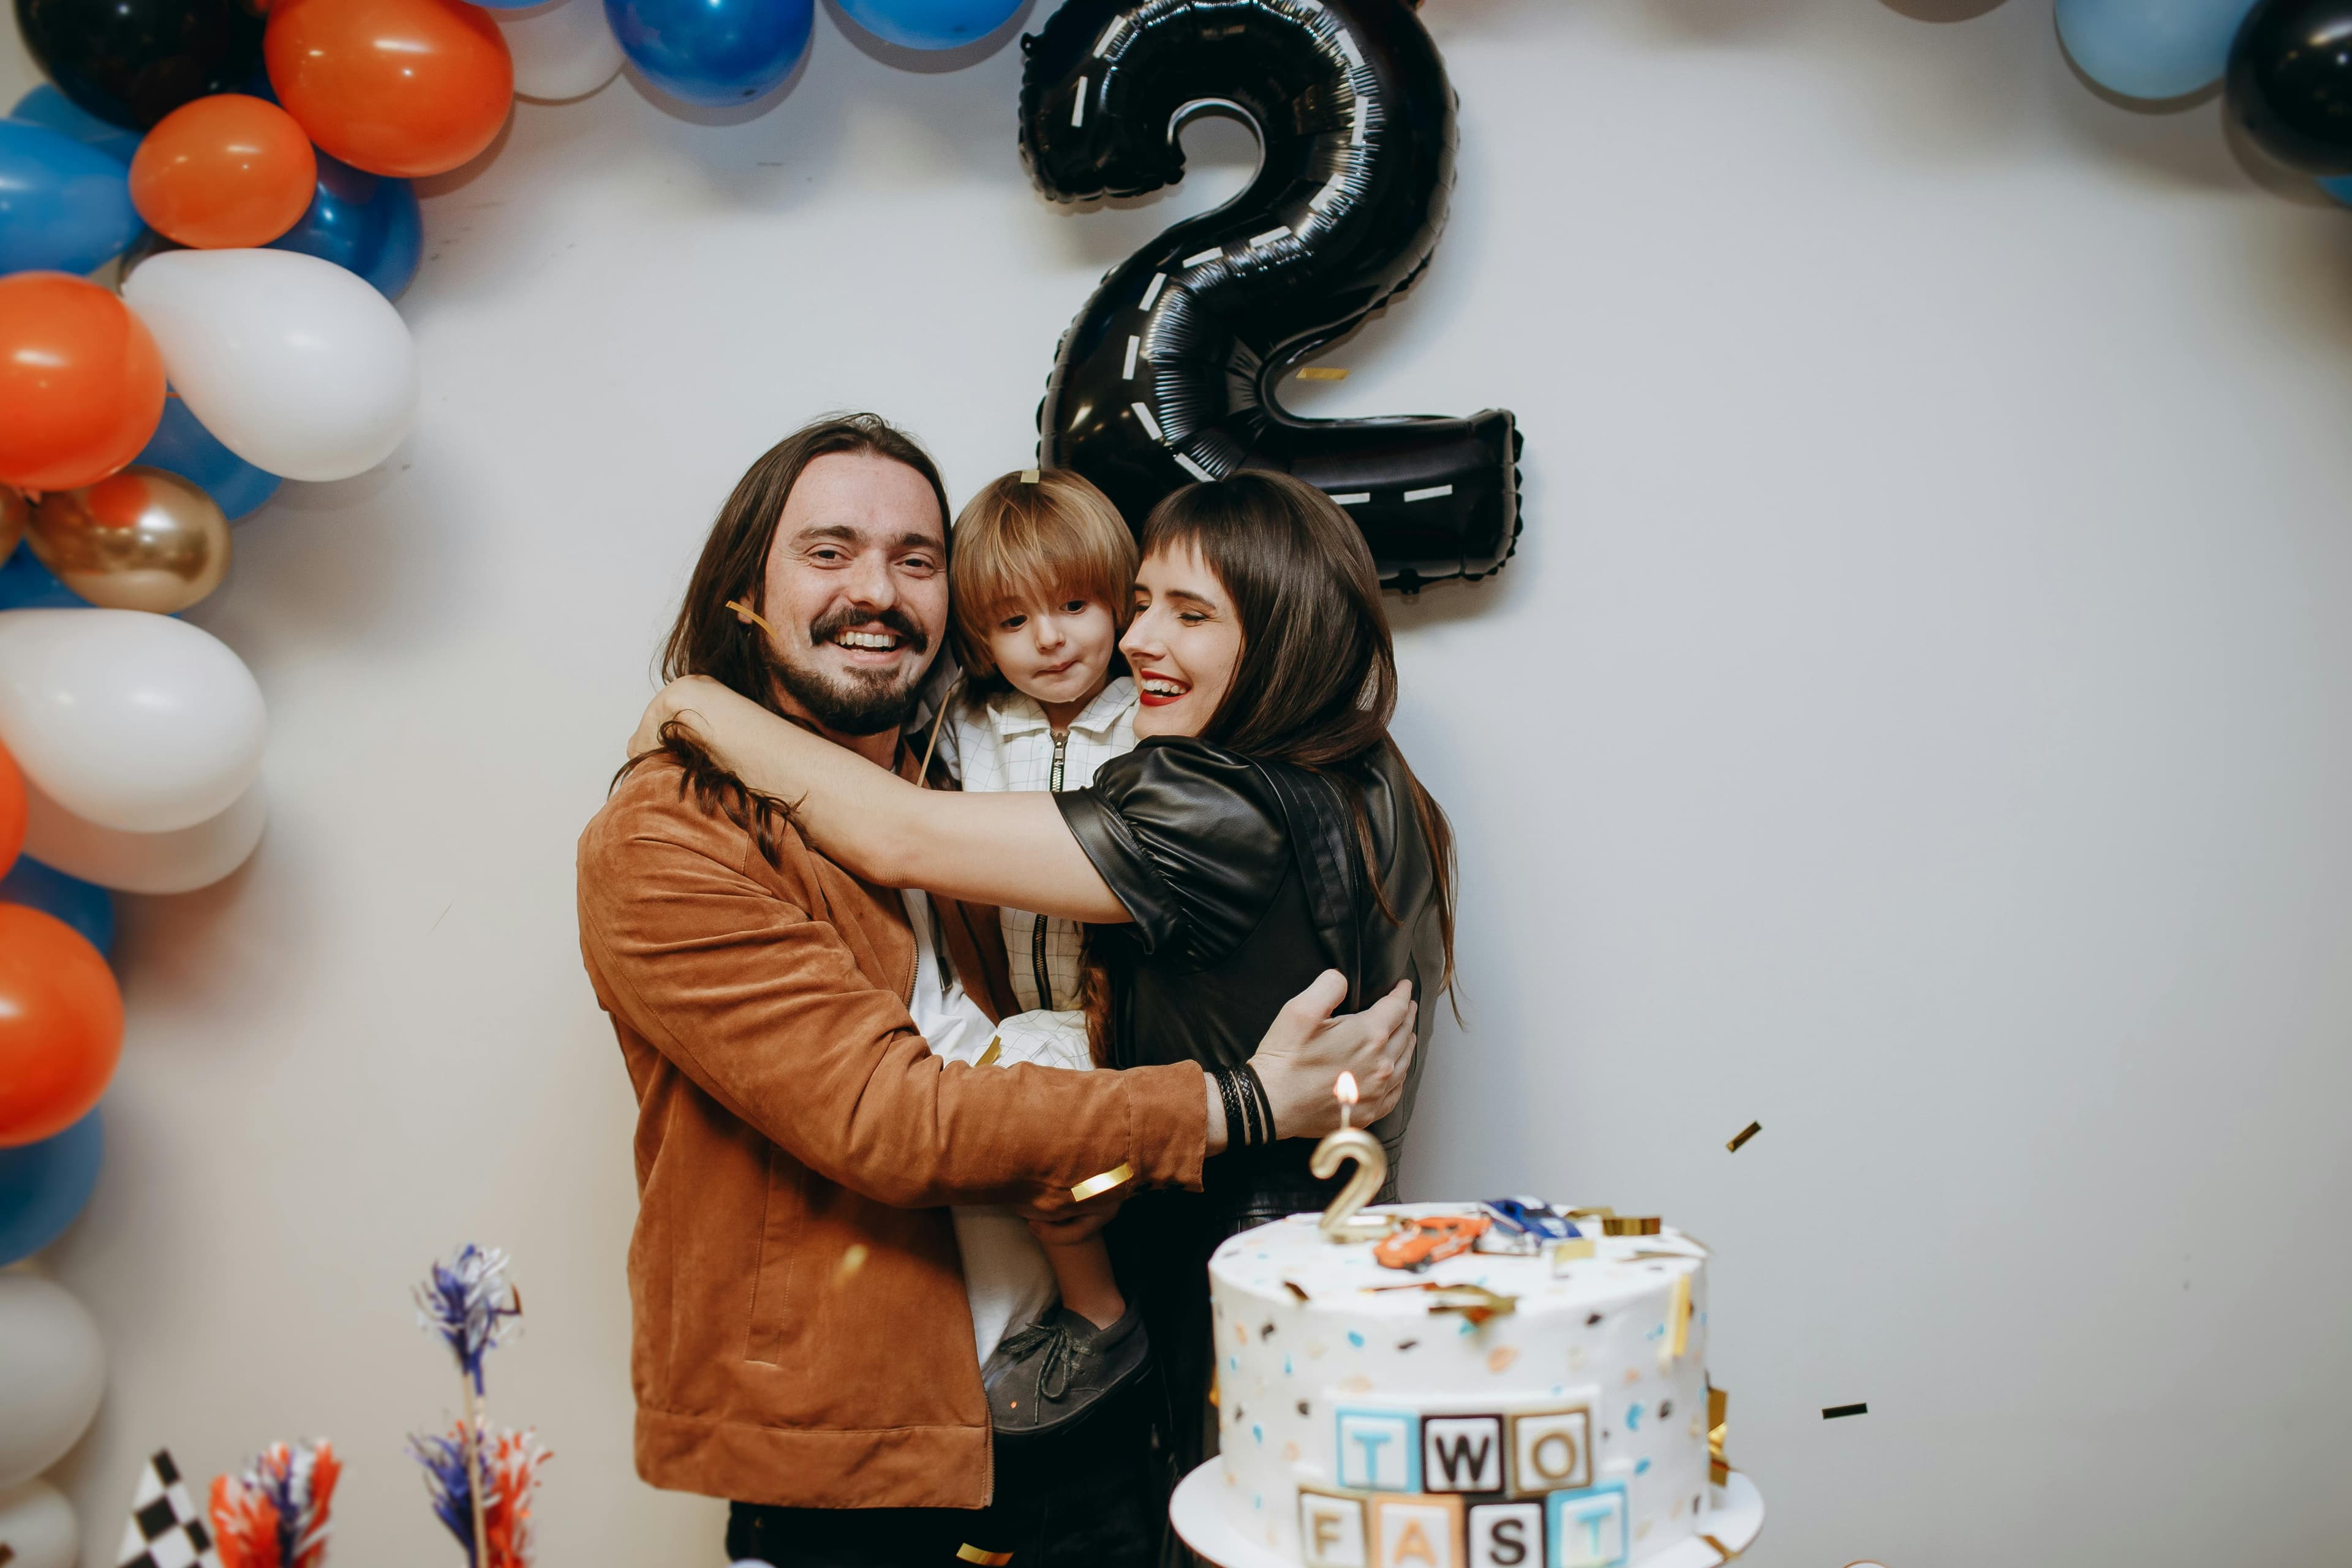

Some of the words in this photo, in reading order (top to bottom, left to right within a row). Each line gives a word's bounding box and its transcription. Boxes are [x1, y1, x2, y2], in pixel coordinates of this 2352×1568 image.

[1019, 0, 1524, 582] 2
[1309, 1126, 1395, 1243] 2
[1350, 1431, 1578, 1482] TWO
[1312, 1506, 1613, 1566] FAST
